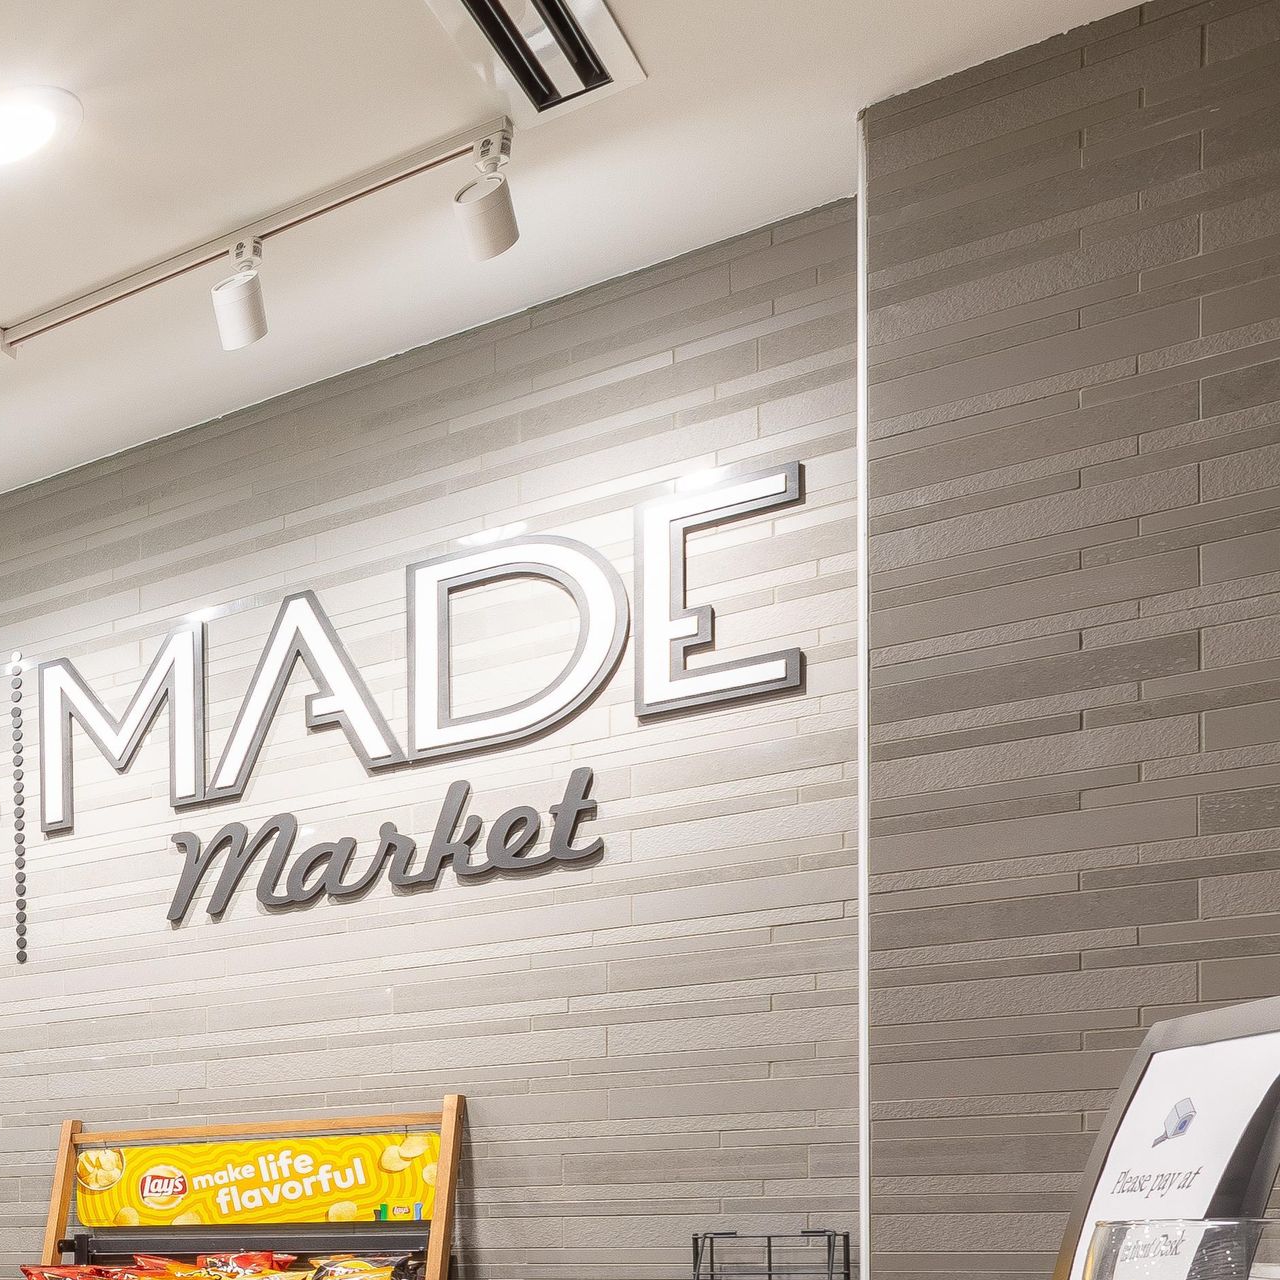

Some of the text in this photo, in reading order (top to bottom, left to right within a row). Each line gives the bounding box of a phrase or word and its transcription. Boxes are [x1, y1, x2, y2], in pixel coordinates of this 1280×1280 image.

[38, 461, 803, 833] MADE
[167, 767, 604, 922] Market
[192, 1150, 315, 1191] make life
[216, 1158, 366, 1214] flavorful
[1110, 1166, 1204, 1198] Please pay at
